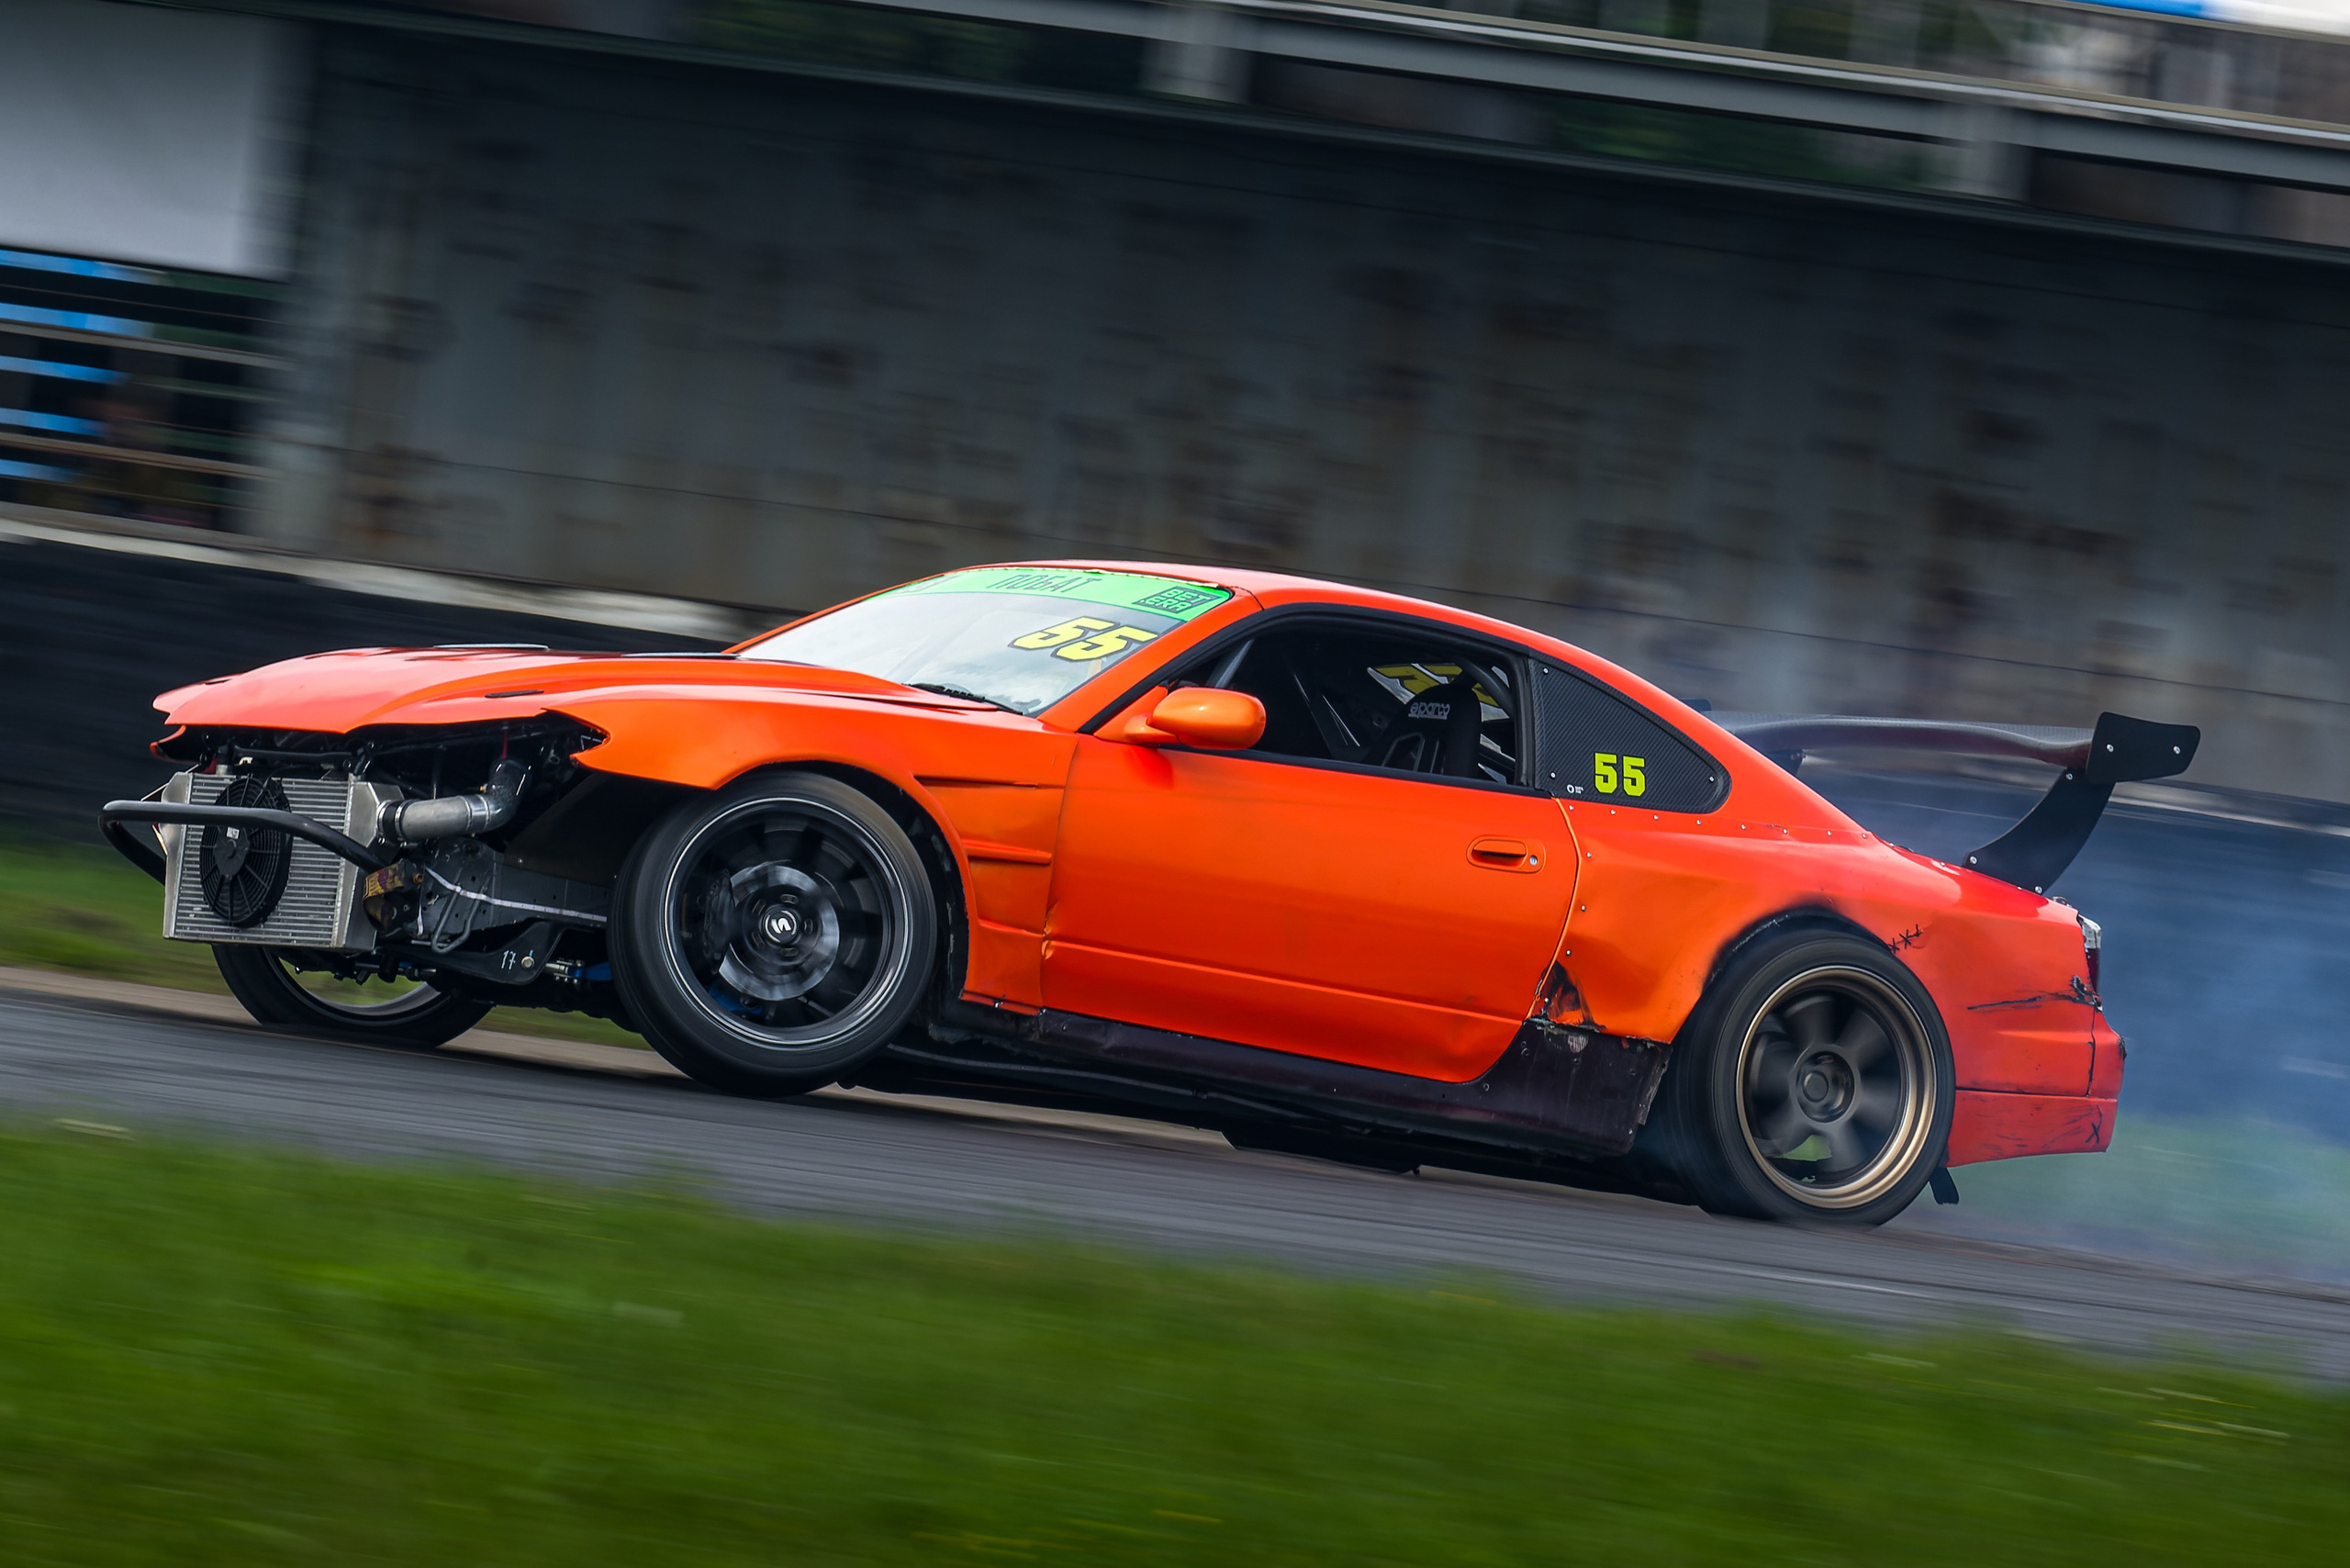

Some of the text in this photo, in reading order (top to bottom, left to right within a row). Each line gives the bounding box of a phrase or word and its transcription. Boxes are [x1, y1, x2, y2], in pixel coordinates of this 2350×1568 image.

[1160, 588, 1212, 604] BET
[1010, 616, 1159, 661] 55
[1595, 752, 1646, 797] 55
[501, 949, 517, 970] 17
